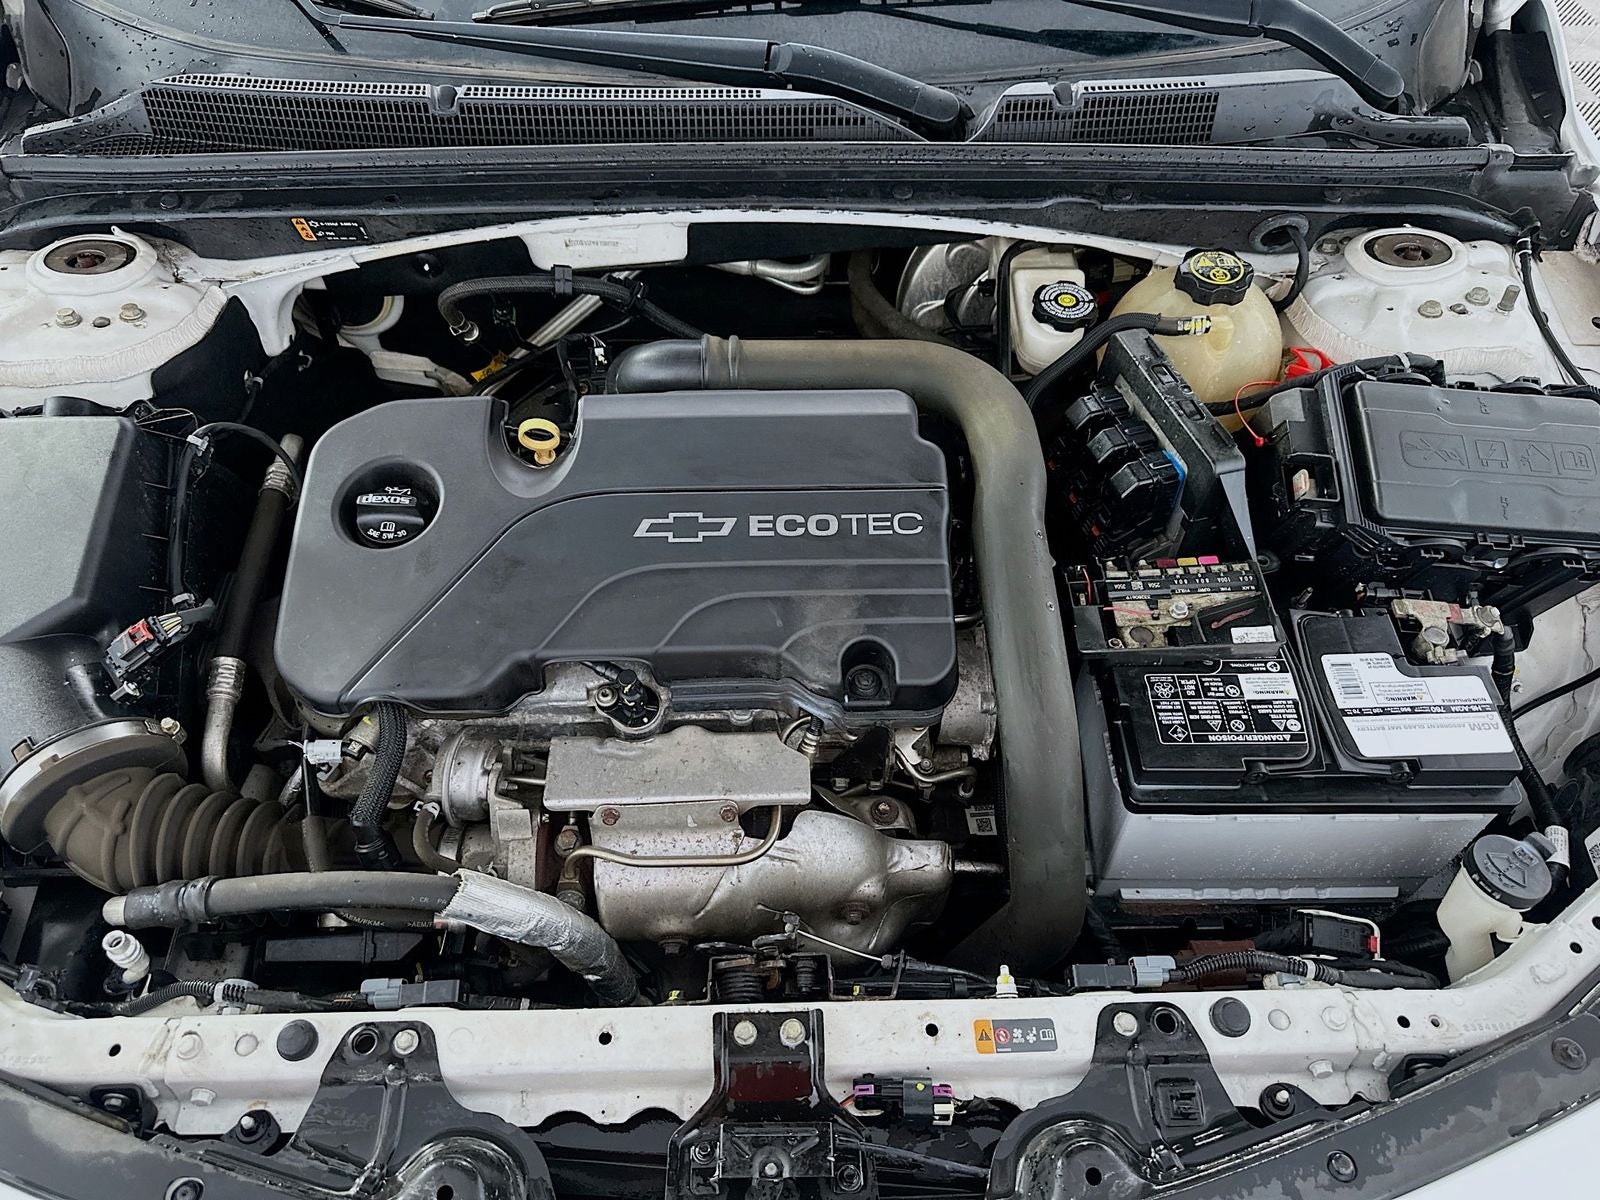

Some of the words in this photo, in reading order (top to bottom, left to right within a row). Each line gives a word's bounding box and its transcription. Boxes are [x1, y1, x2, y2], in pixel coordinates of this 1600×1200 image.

[362, 494, 410, 504] dexos
[749, 512, 924, 537] ECOTEC
[367, 528, 380, 538] SAE
[382, 530, 407, 540] 5W-30
[1468, 722, 1499, 730] AGM
[1208, 734, 1284, 742] DANGER/POISON
